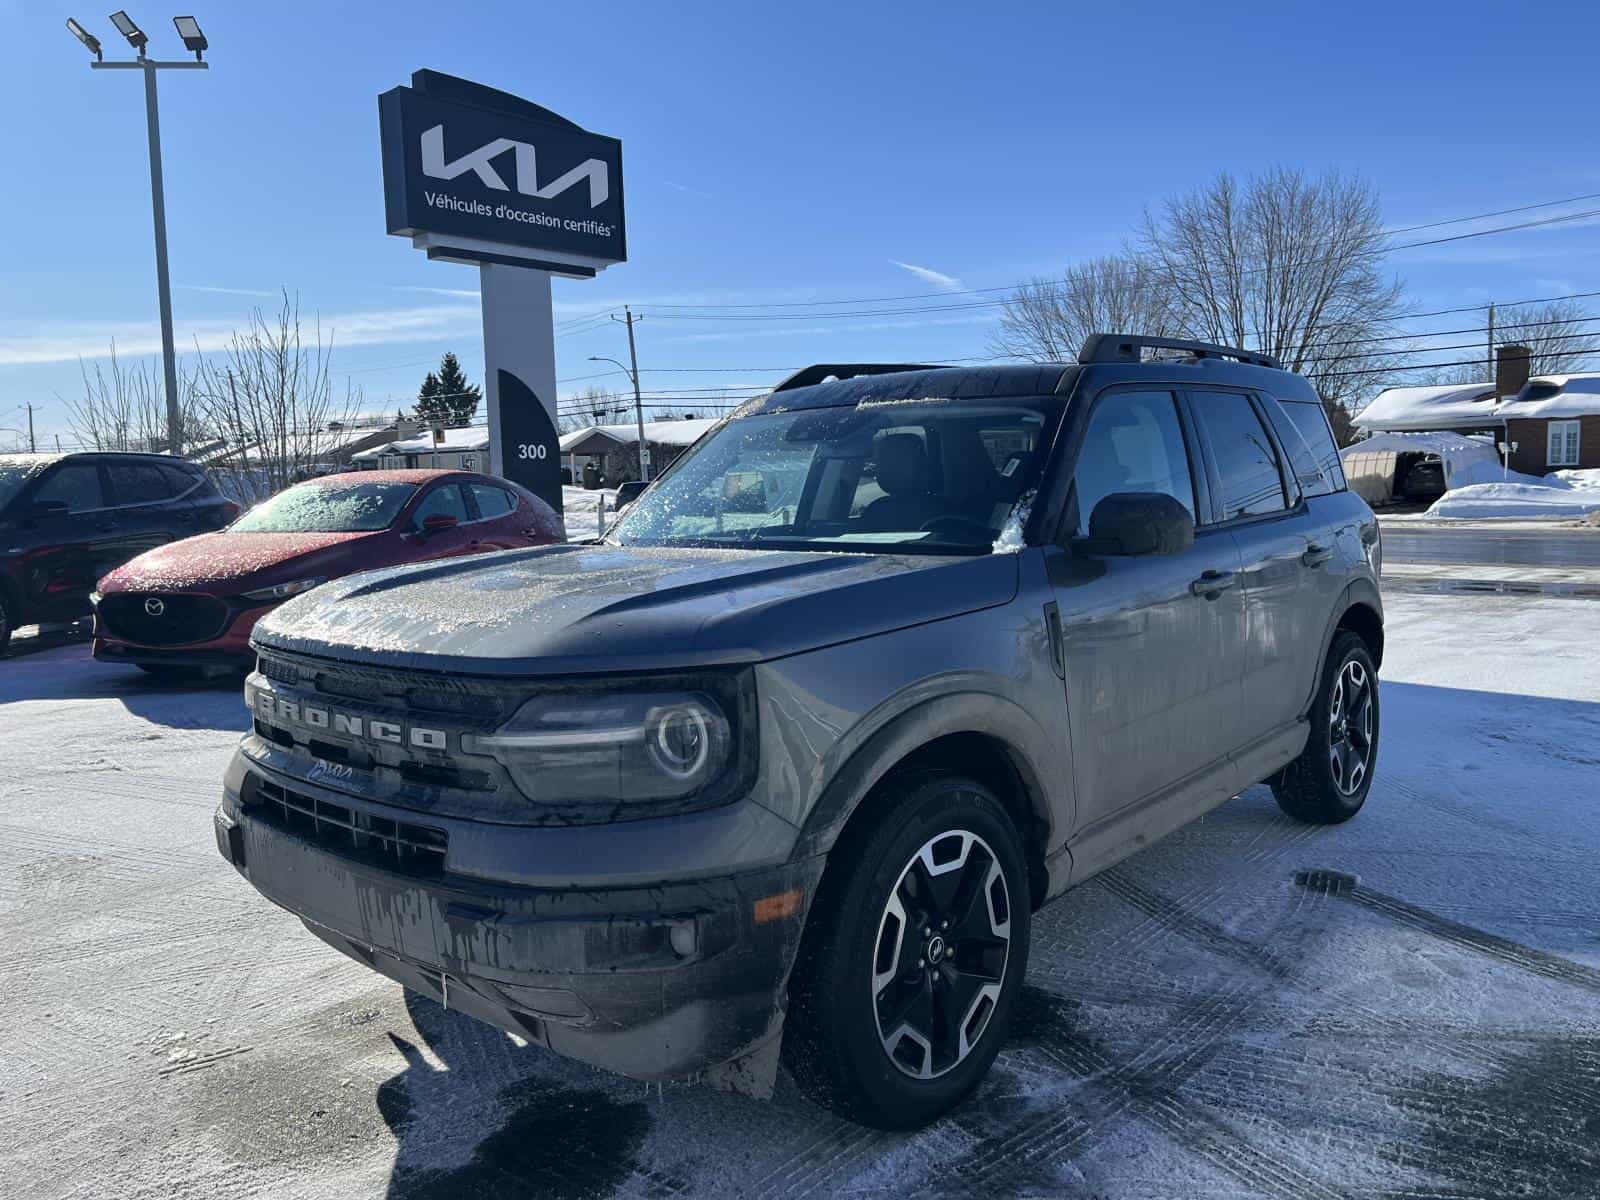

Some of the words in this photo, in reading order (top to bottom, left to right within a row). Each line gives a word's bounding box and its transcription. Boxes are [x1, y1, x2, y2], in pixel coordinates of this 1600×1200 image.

[421, 124, 609, 208] KIA
[424, 191, 492, 217] Véhicules
[495, 205, 561, 229] d'occasion
[563, 216, 611, 237] certifiés
[518, 444, 546, 459] 300
[257, 692, 447, 750] BRONCO
